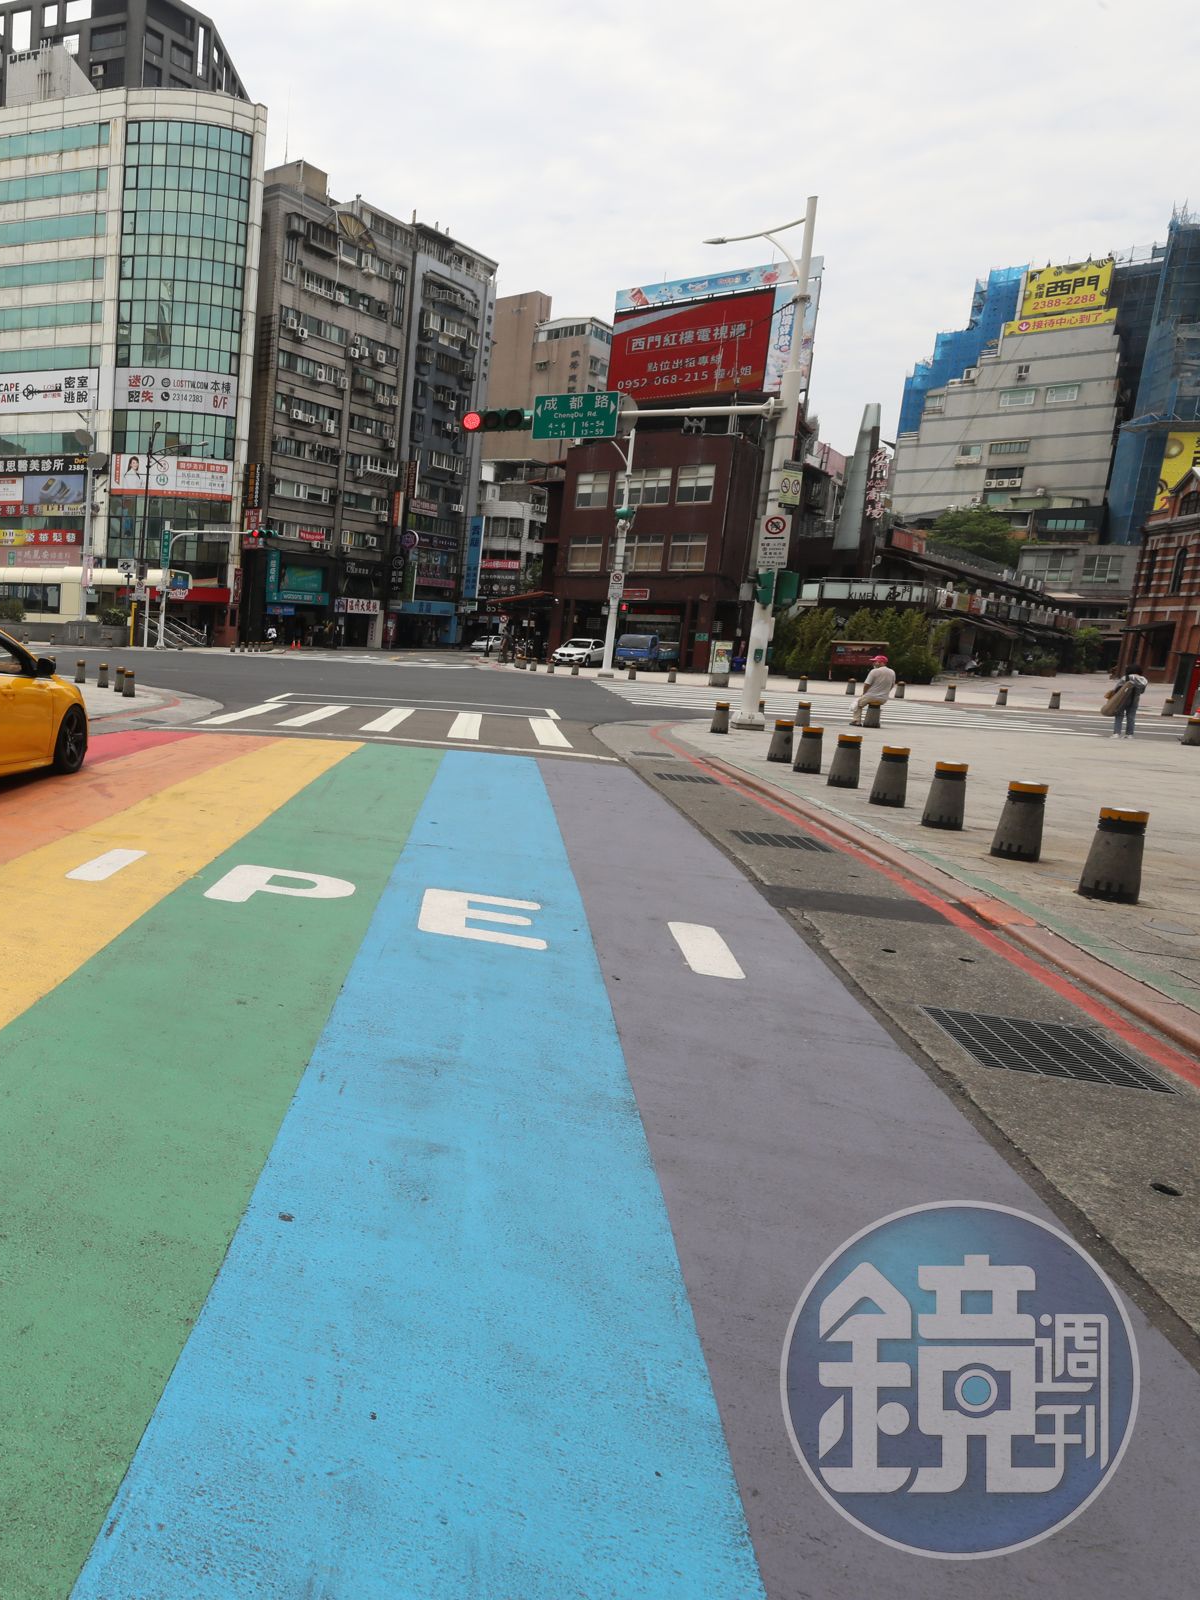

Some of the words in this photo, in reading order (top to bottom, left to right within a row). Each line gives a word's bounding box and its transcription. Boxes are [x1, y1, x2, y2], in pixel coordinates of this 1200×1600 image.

[1045, 275, 1100, 298] 西門
[1032, 294, 1097, 311] 2388-2288
[1031, 313, 1103, 330] 接待中心到了
[631, 323, 747, 352] 西門紅樓電視牆
[64, 376, 88, 388] 密室
[210, 380, 231, 394] 本棟
[63, 391, 88, 403] 逃脫
[212, 395, 228, 410] 6/F
[544, 395, 609, 411] 成都路
[553, 411, 584, 419] ChengDu
